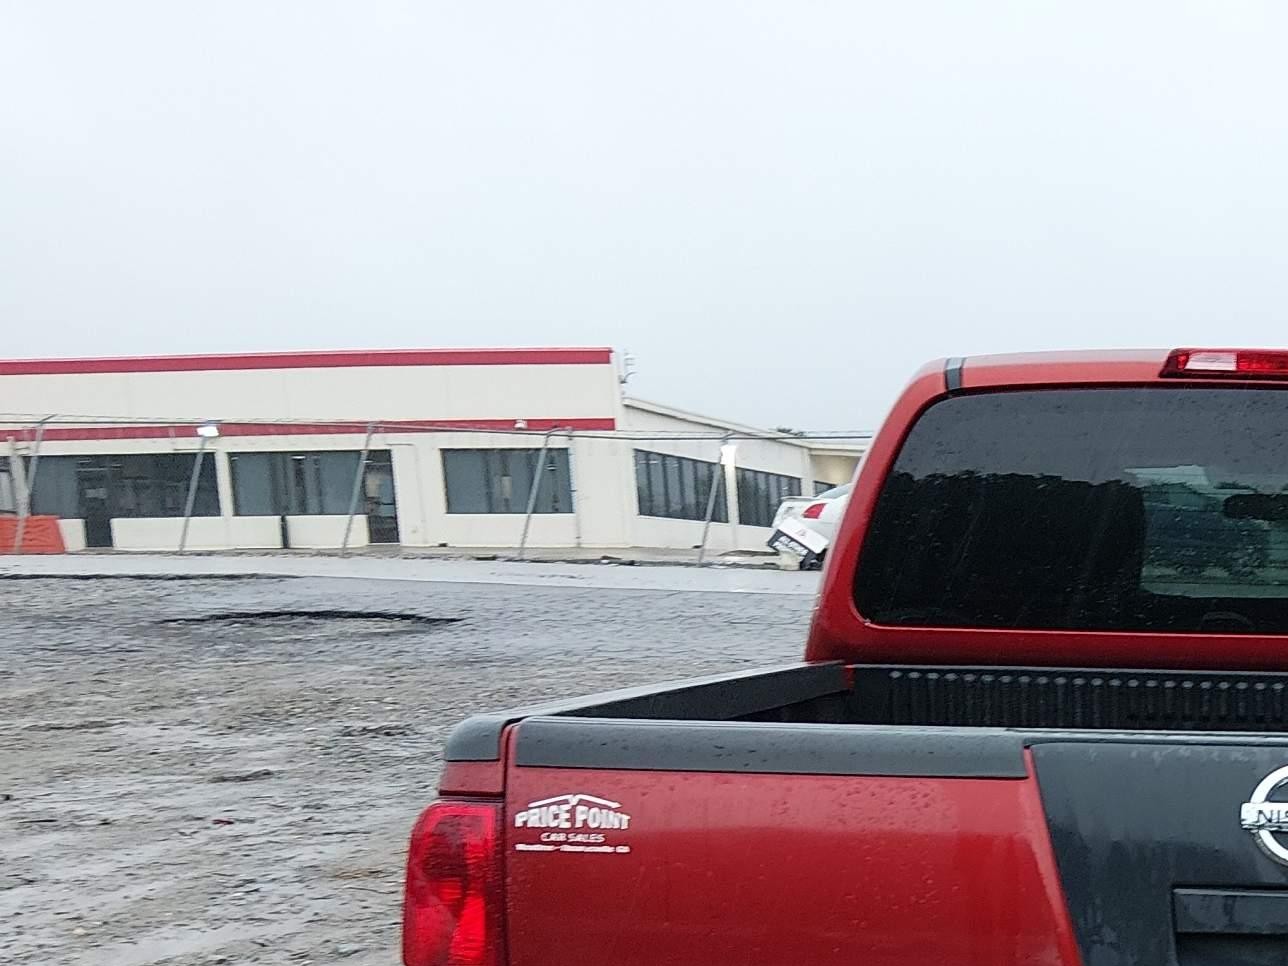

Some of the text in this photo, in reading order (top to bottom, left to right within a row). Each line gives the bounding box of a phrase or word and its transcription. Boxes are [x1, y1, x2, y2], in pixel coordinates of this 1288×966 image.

[514, 804, 631, 830] PRICE POINT
[540, 832, 606, 843] CAR SALES
